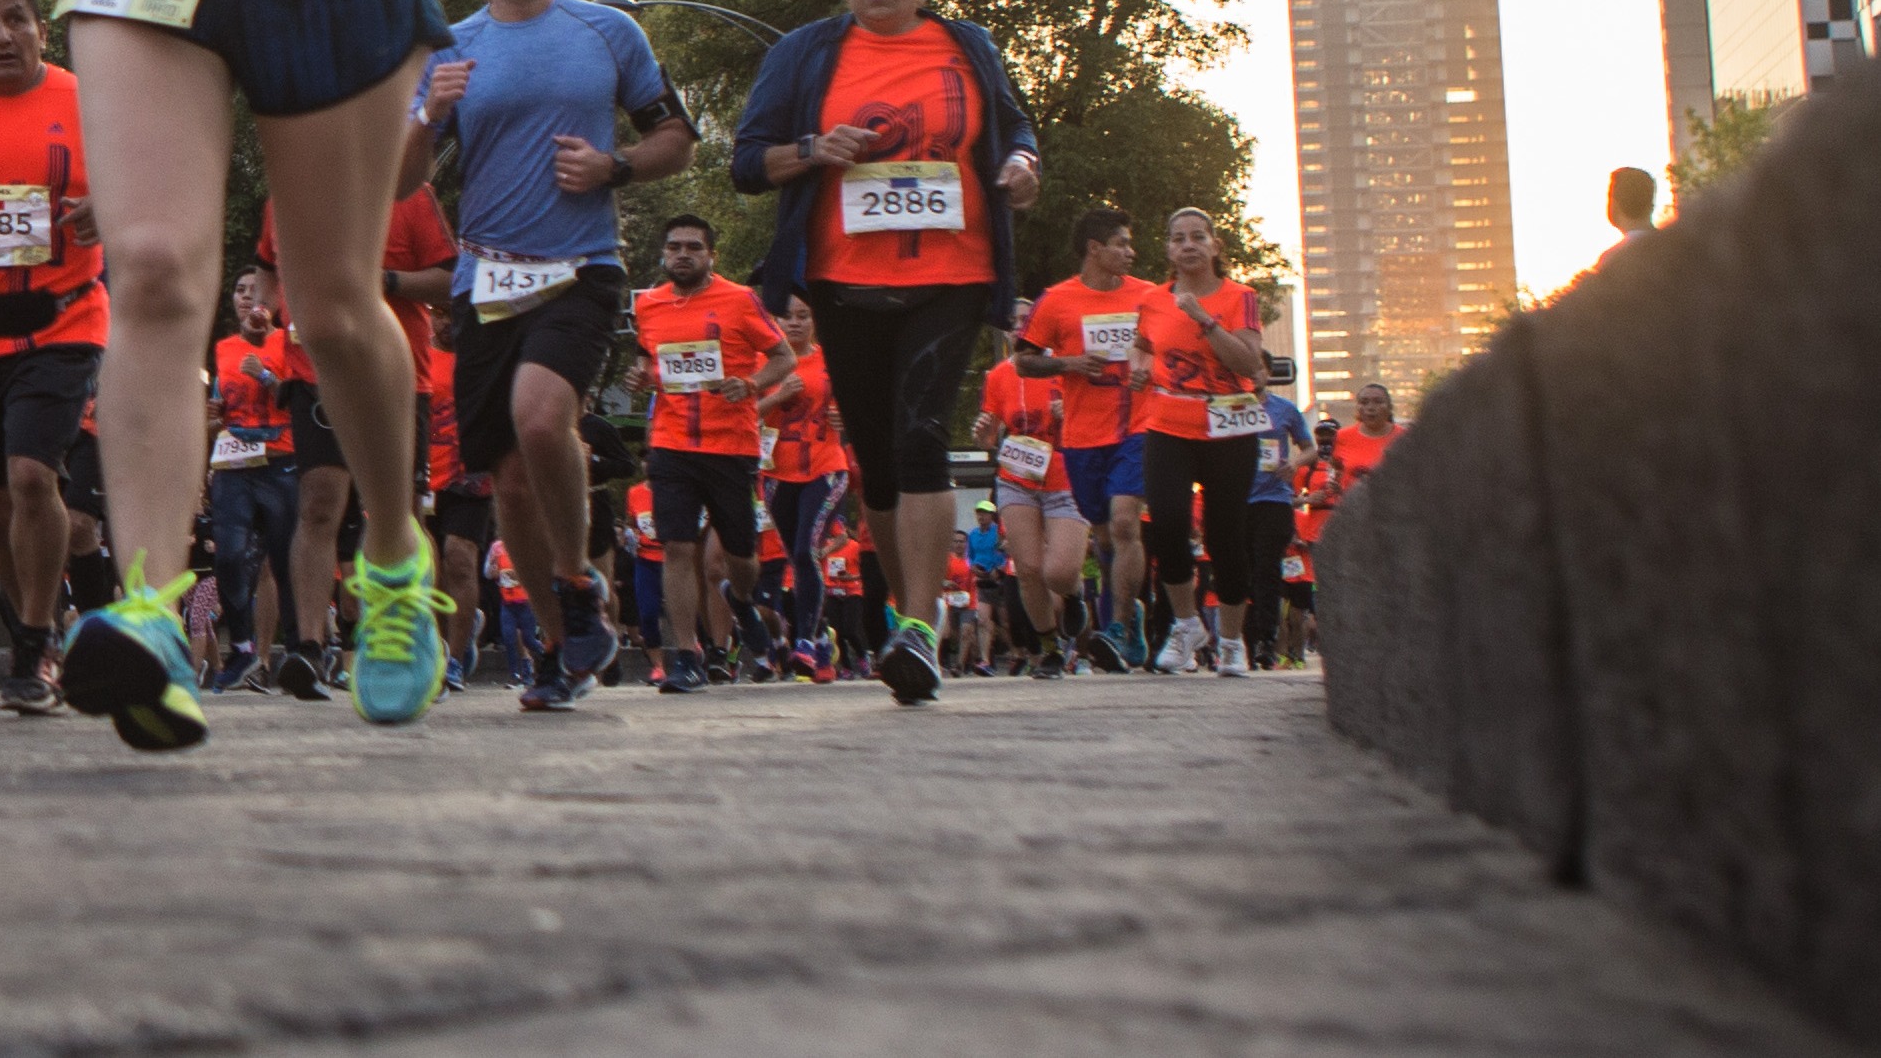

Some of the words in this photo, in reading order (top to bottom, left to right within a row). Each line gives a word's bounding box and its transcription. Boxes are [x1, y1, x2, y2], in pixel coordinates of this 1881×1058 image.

[861, 190, 947, 216] 2886
[665, 357, 717, 375] 18289
[1216, 409, 1268, 429] 24103
[1001, 445, 1045, 468] 20169
